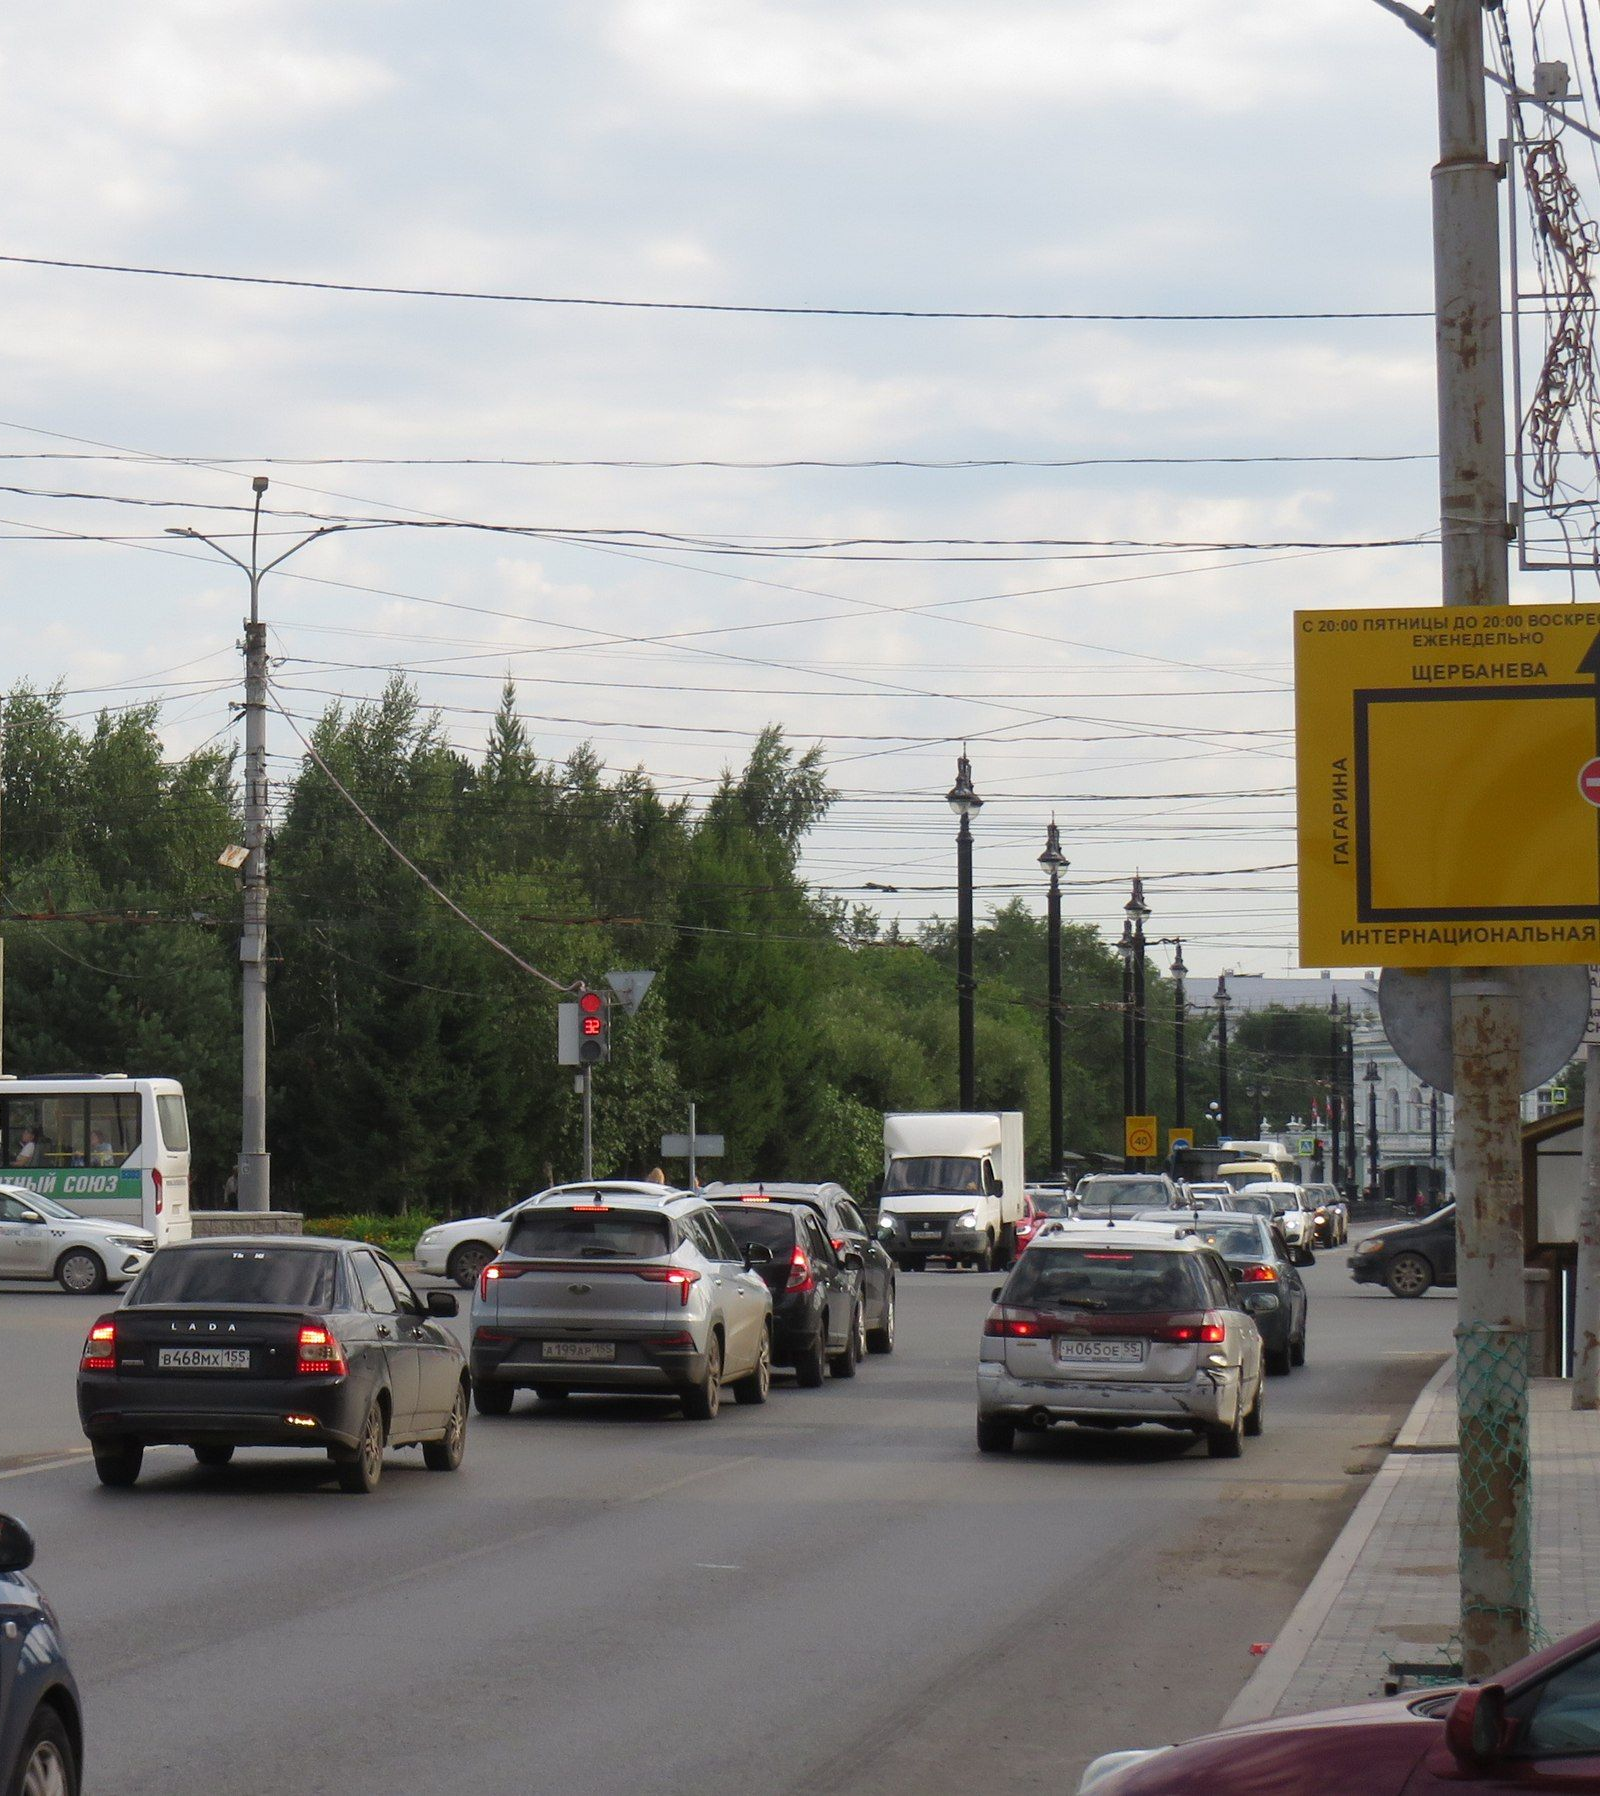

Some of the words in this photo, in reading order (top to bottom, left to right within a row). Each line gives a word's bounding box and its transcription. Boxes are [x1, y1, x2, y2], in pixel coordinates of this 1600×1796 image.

[1303, 621, 1313, 632] С
[1318, 620, 1358, 632] 20:00
[1363, 617, 1448, 631] ПЯТНИЦЫ
[1453, 616, 1477, 630] ДО
[1483, 616, 1522, 629] 20:00
[1528, 612, 1600, 627] ВОСКРЕ
[1413, 632, 1544, 647] ЕЖЕНЕДЕЛЬНО
[1412, 663, 1548, 682] ЩЕРБАНЕВА
[1332, 757, 1349, 865] ГАГАРИНА
[1340, 925, 1596, 945] ИНТЕРНАЦИОНАЛЬНАЯ
[585, 1020, 600, 1034] 32
[1135, 1136, 1148, 1146] 40
[171, 1322, 236, 1332] LADA
[1065, 1342, 1119, 1356] Н065ОЕ
[163, 1351, 221, 1366] В468МХ
[224, 1351, 246, 1362] 155
